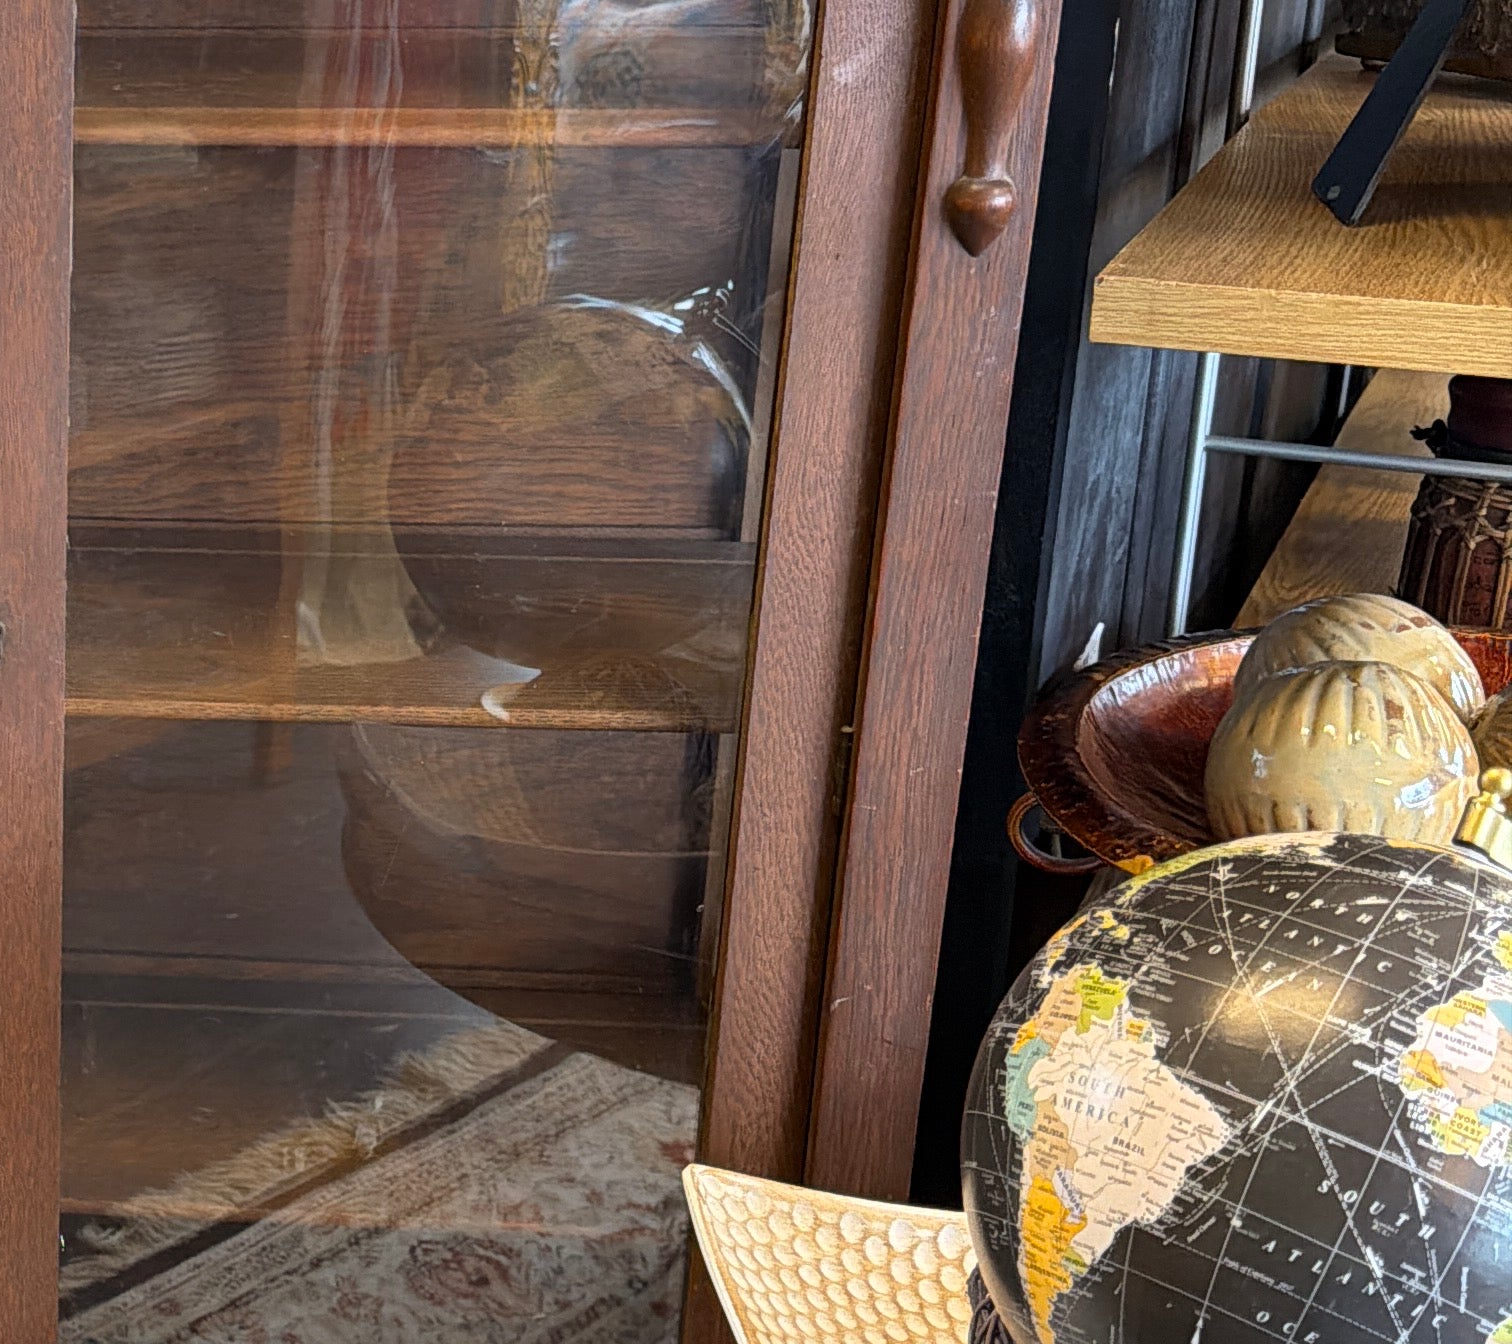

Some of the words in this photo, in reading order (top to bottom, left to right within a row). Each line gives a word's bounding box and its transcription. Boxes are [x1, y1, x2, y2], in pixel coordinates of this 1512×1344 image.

[1434, 1030, 1493, 1057] MAURITANIA
[1067, 1071, 1127, 1099] SOUTH
[1050, 1094, 1130, 1129] AMERICA
[1454, 1112, 1481, 1128] IVORY
[1450, 1120, 1482, 1137] COAST
[1112, 1135, 1145, 1157] BRAZIL
[1316, 1178, 1436, 1241] SOUTH
[1261, 1239, 1447, 1329] ATLANTIC
